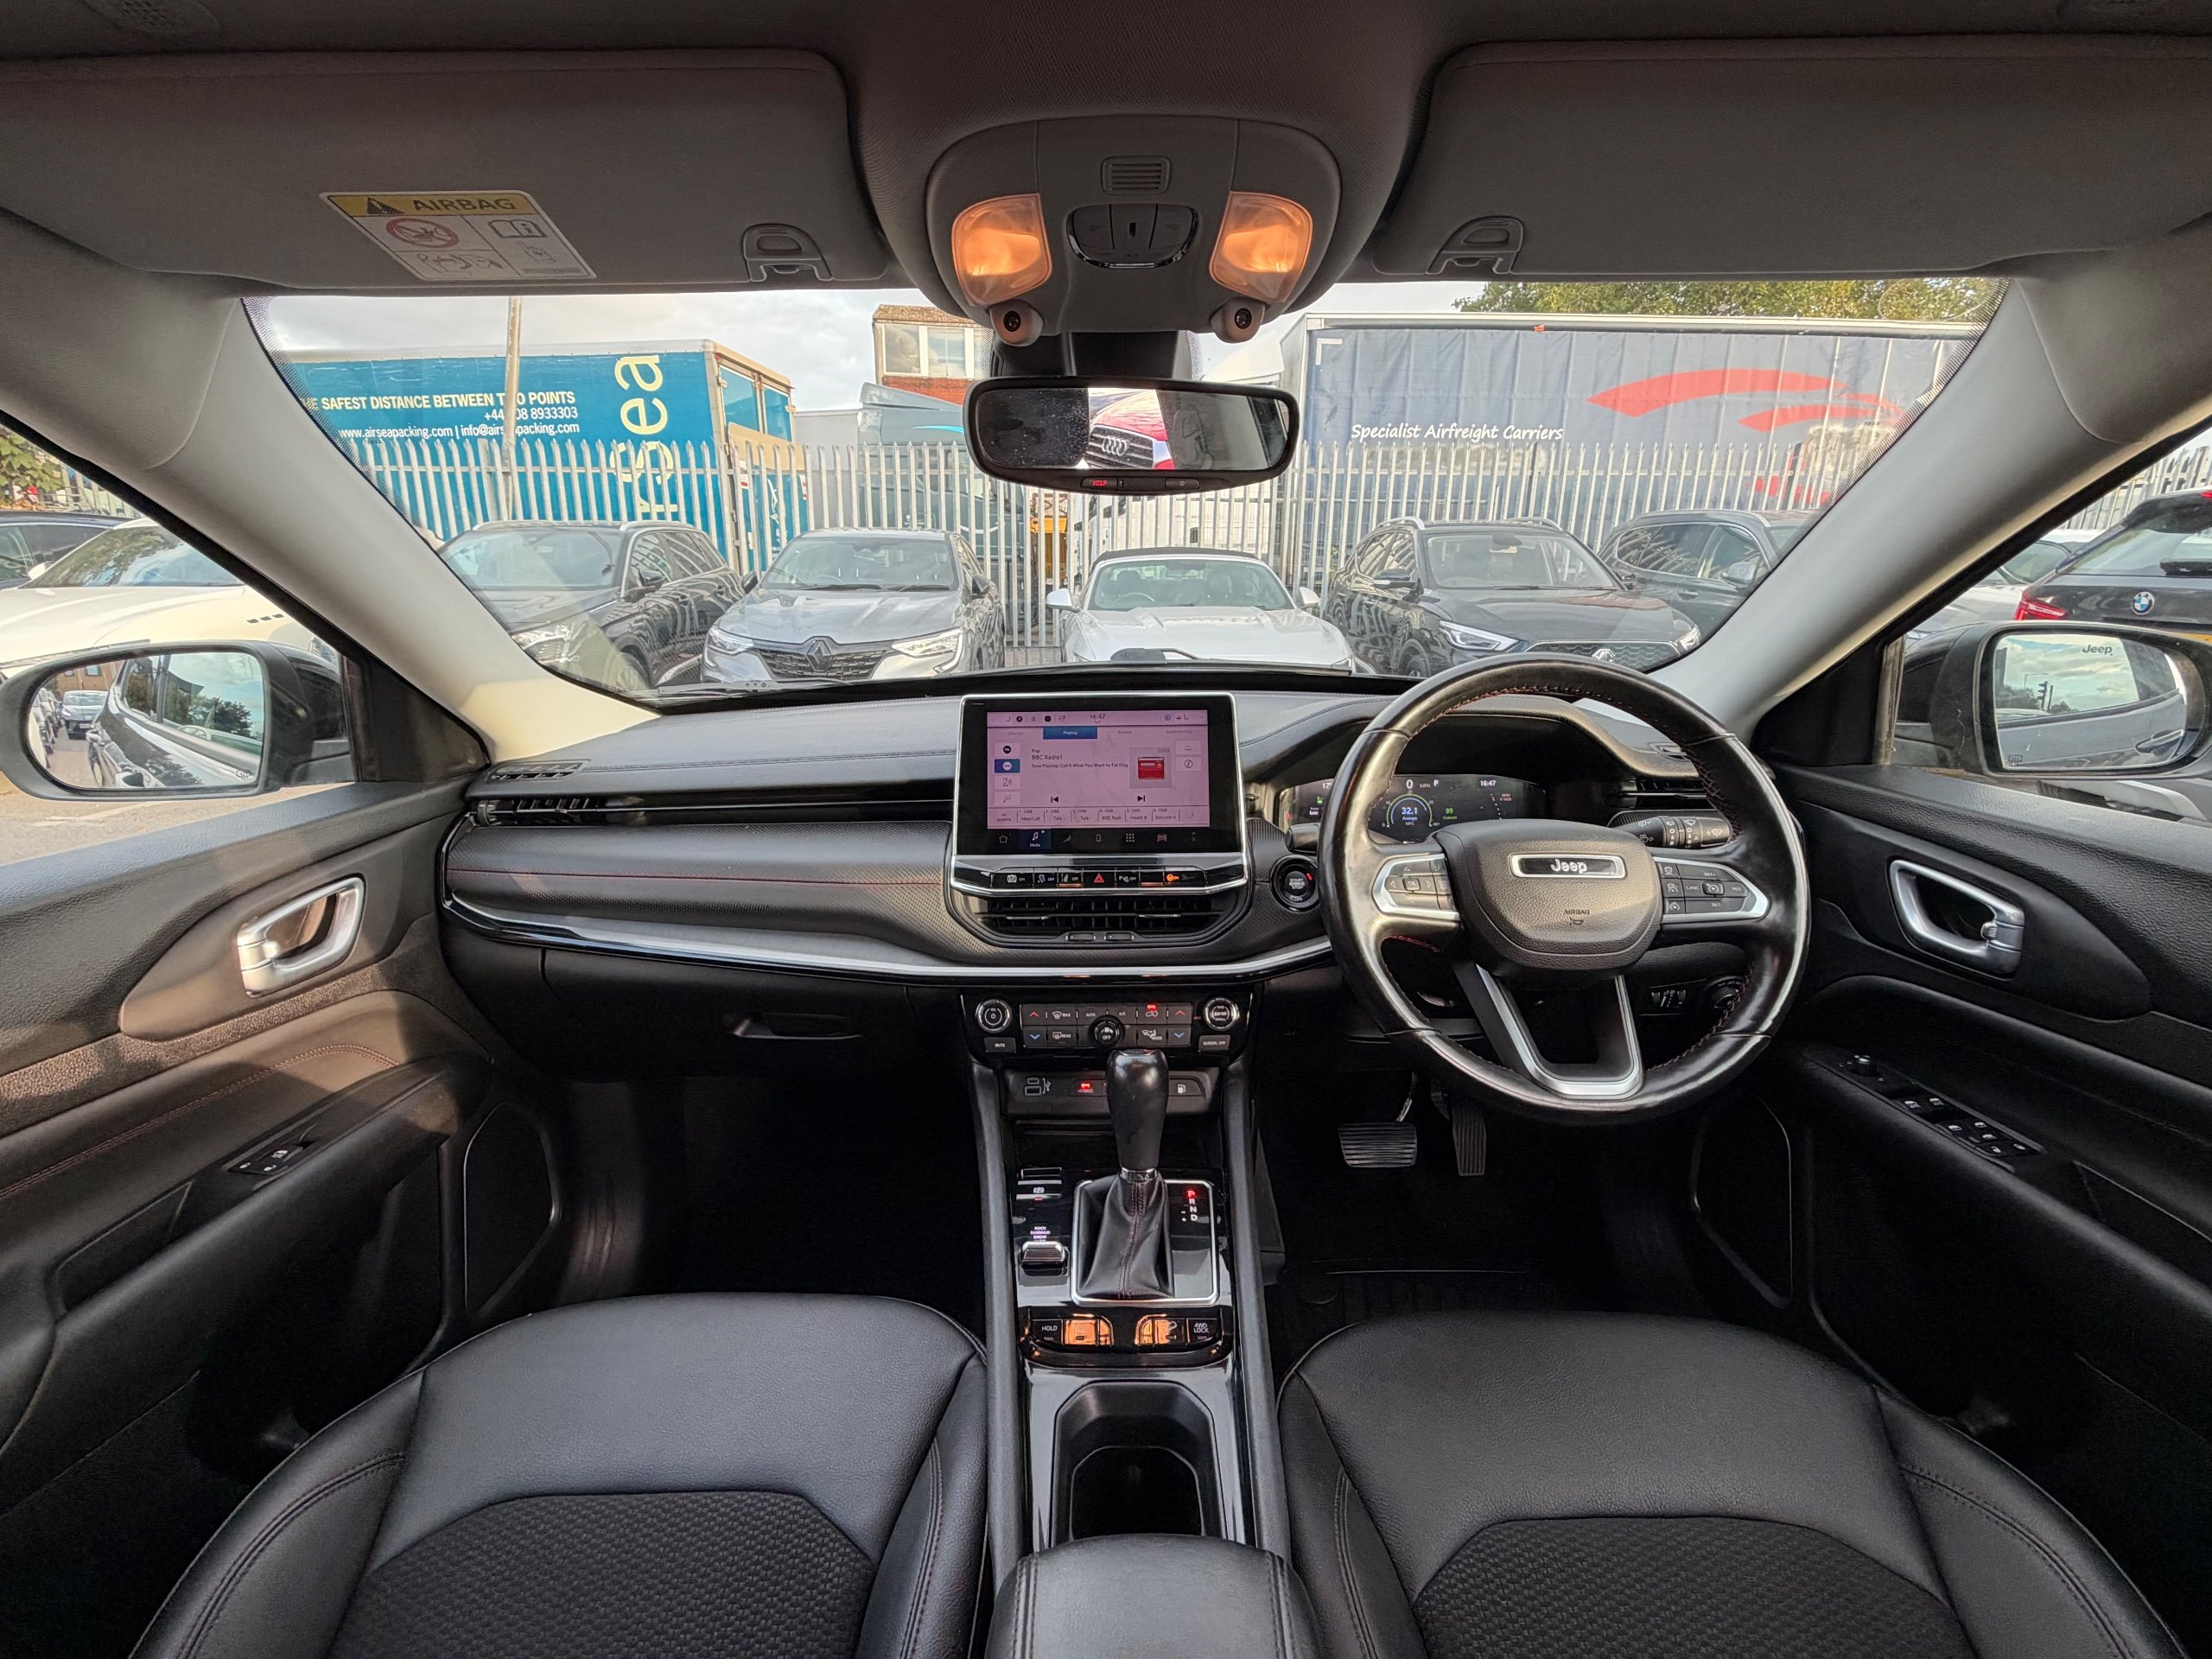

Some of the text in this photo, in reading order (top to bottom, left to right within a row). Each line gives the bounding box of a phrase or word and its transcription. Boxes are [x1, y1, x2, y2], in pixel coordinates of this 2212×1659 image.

[413, 198, 517, 211] AIRBAG
[321, 397, 367, 410] SAFEST
[370, 395, 431, 410] DISTANCE
[433, 393, 494, 408] BETWEEN
[496, 392, 526, 406] TO
[528, 391, 575, 405] POINTS
[531, 406, 578, 420] 8933303
[461, 422, 580, 435] info@airspacking.com
[609, 355, 680, 513] rsea
[1351, 423, 1564, 443] Specialist Airfreight Carriers
[2082, 644, 2113, 655] Jeep
[1402, 806, 1418, 815] 32.1
[1550, 858, 1588, 874] Jeep
[1187, 1190, 1196, 1198] P
